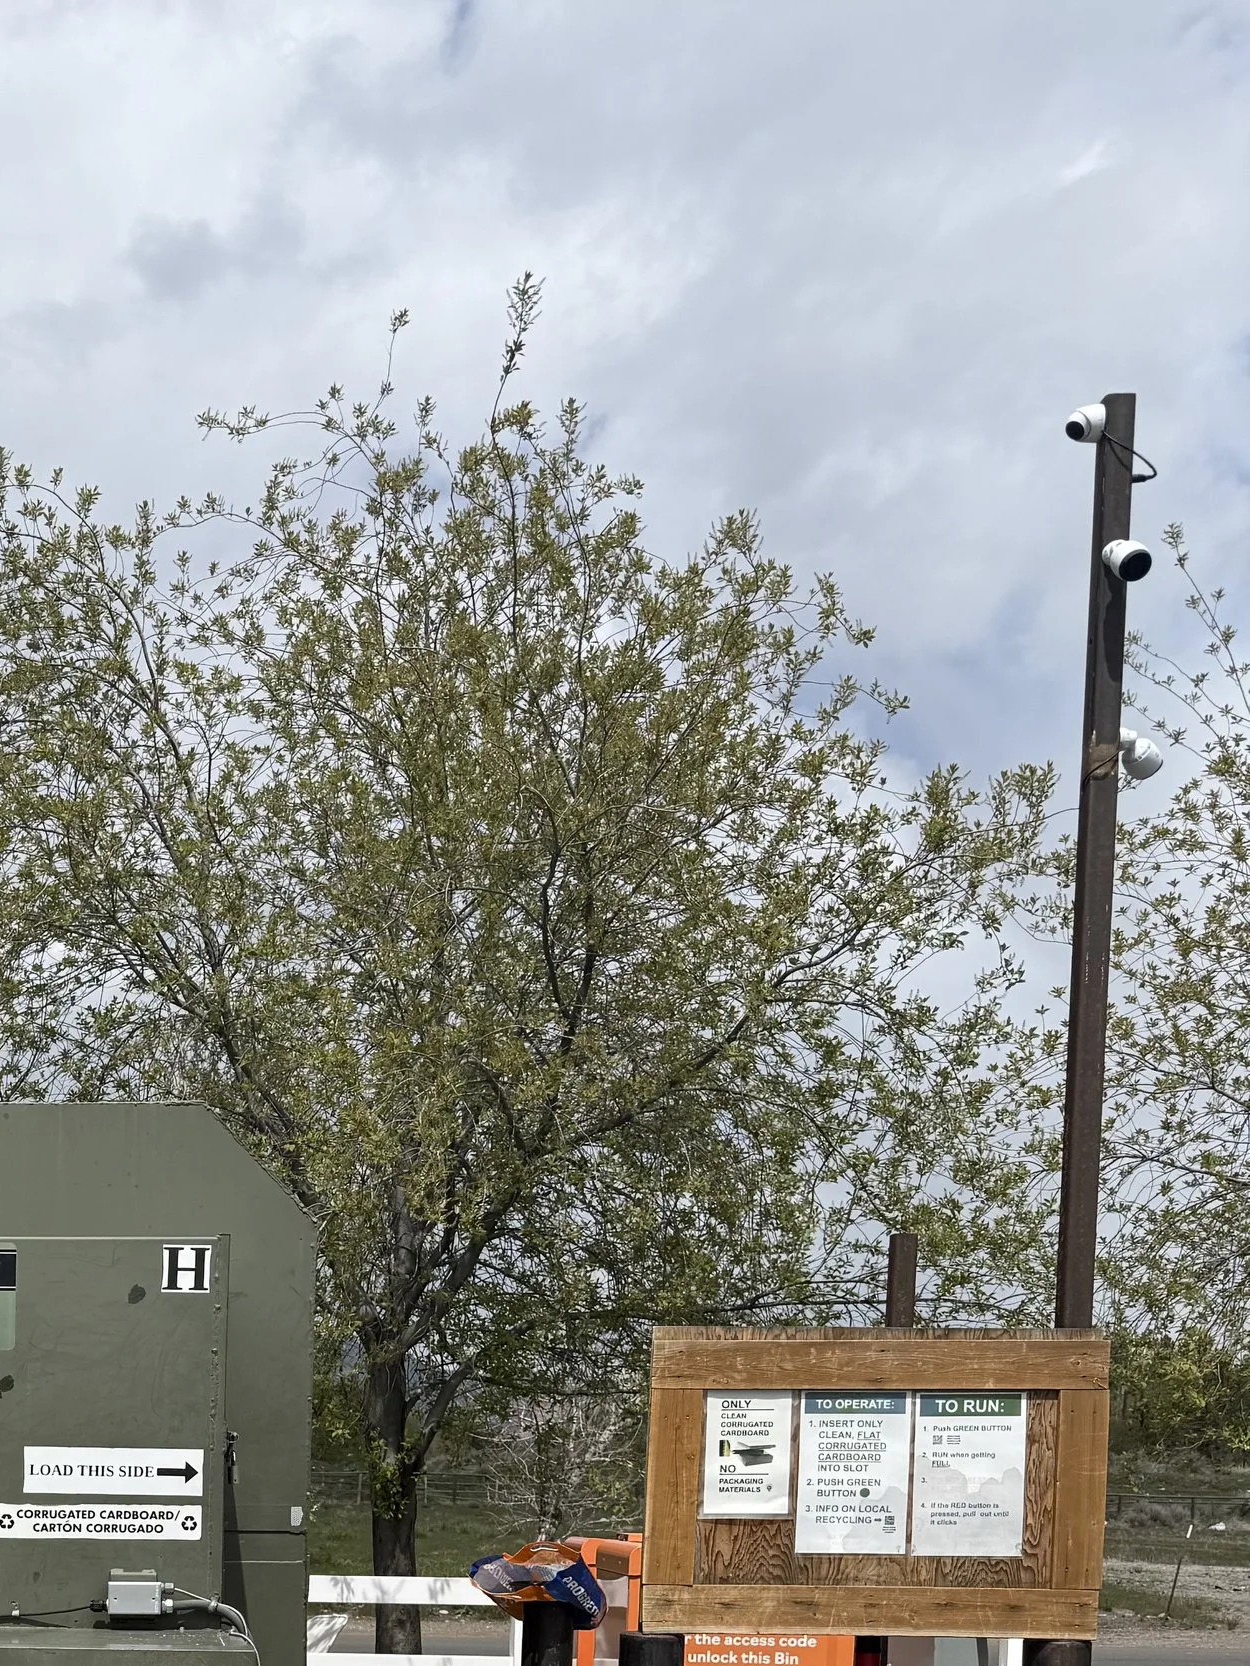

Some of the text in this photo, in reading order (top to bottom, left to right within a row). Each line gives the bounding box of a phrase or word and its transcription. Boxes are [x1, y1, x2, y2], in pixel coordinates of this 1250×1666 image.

[162, 1247, 210, 1290] H
[721, 1400, 752, 1409] ONLY
[816, 1399, 895, 1409] TO OPERATE:
[935, 1399, 1005, 1413] TO RUN:
[819, 1420, 855, 1428] INSERT
[857, 1420, 883, 1428] ONLY
[857, 1431, 881, 1439] FLAT
[818, 1442, 887, 1450] CORRUGATED
[818, 1453, 881, 1461] CARDBOARD
[29, 1464, 155, 1478] LOAD THIS SIDE
[719, 1464, 736, 1473] NO
[817, 1464, 869, 1472] INTO SLOT
[817, 1478, 844, 1486] PUSH
[847, 1478, 881, 1486] GREEN
[817, 1489, 857, 1497] BUTTON
[815, 1505, 839, 1513] INFO
[841, 1505, 856, 1513] ON
[858, 1505, 892, 1513] LOCAL
[16, 1509, 95, 1520] CORRUGATED
[815, 1516, 872, 1524] RECYCLING
[32, 1520, 164, 1534] CARTÓN CORRUGADO
[694, 1634, 721, 1646] the
[724, 1637, 776, 1647] access
[779, 1635, 817, 1648] code
[687, 1650, 799, 1665] unlock this Bin
